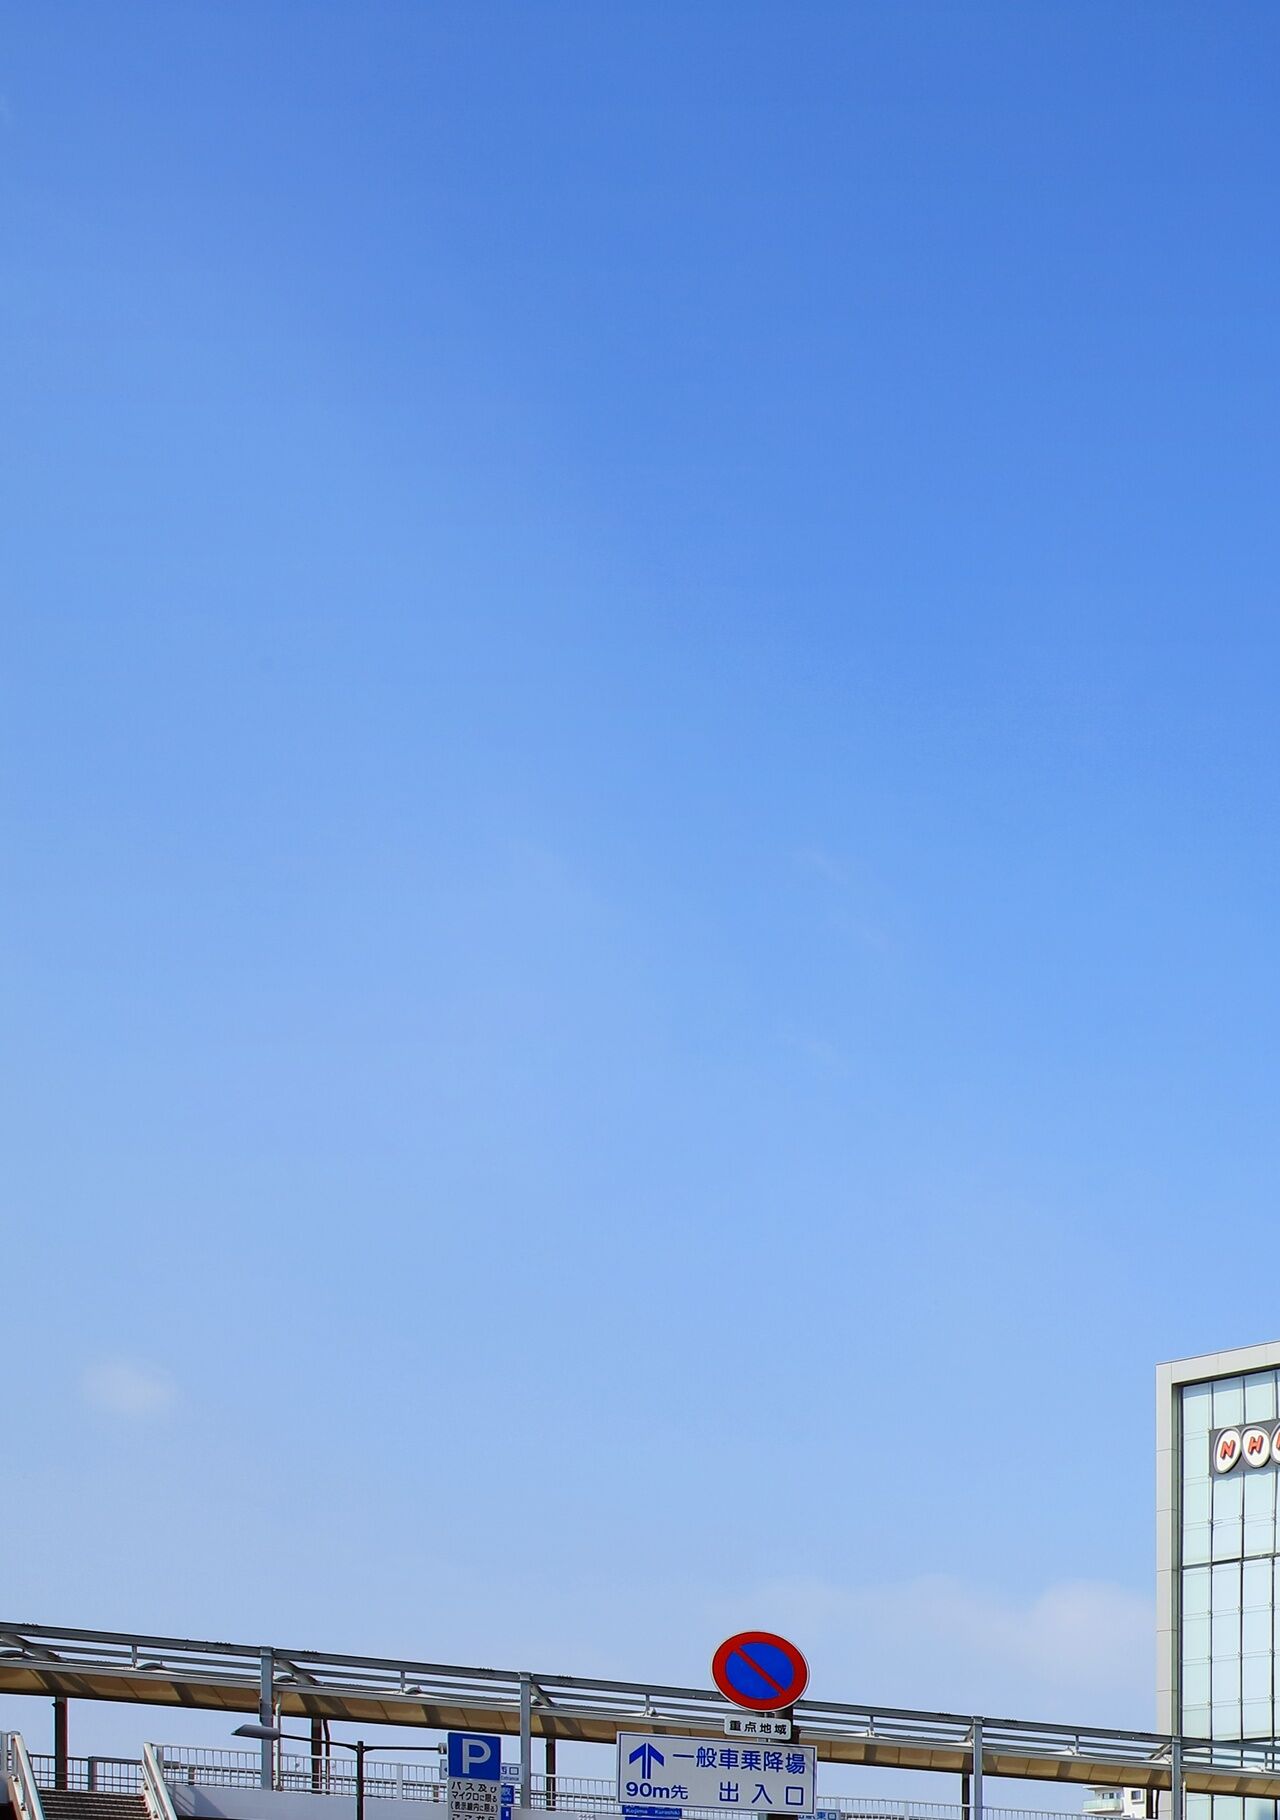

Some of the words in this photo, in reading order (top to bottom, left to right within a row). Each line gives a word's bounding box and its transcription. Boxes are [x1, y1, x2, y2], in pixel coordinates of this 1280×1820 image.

[730, 1720, 787, 1735] 重点地域
[462, 1738, 491, 1775] P
[672, 1746, 806, 1775] 一般車乗降場
[451, 1781, 497, 1793] バス及び
[625, 1781, 689, 1800] 90m先
[719, 1781, 804, 1806] 出入口
